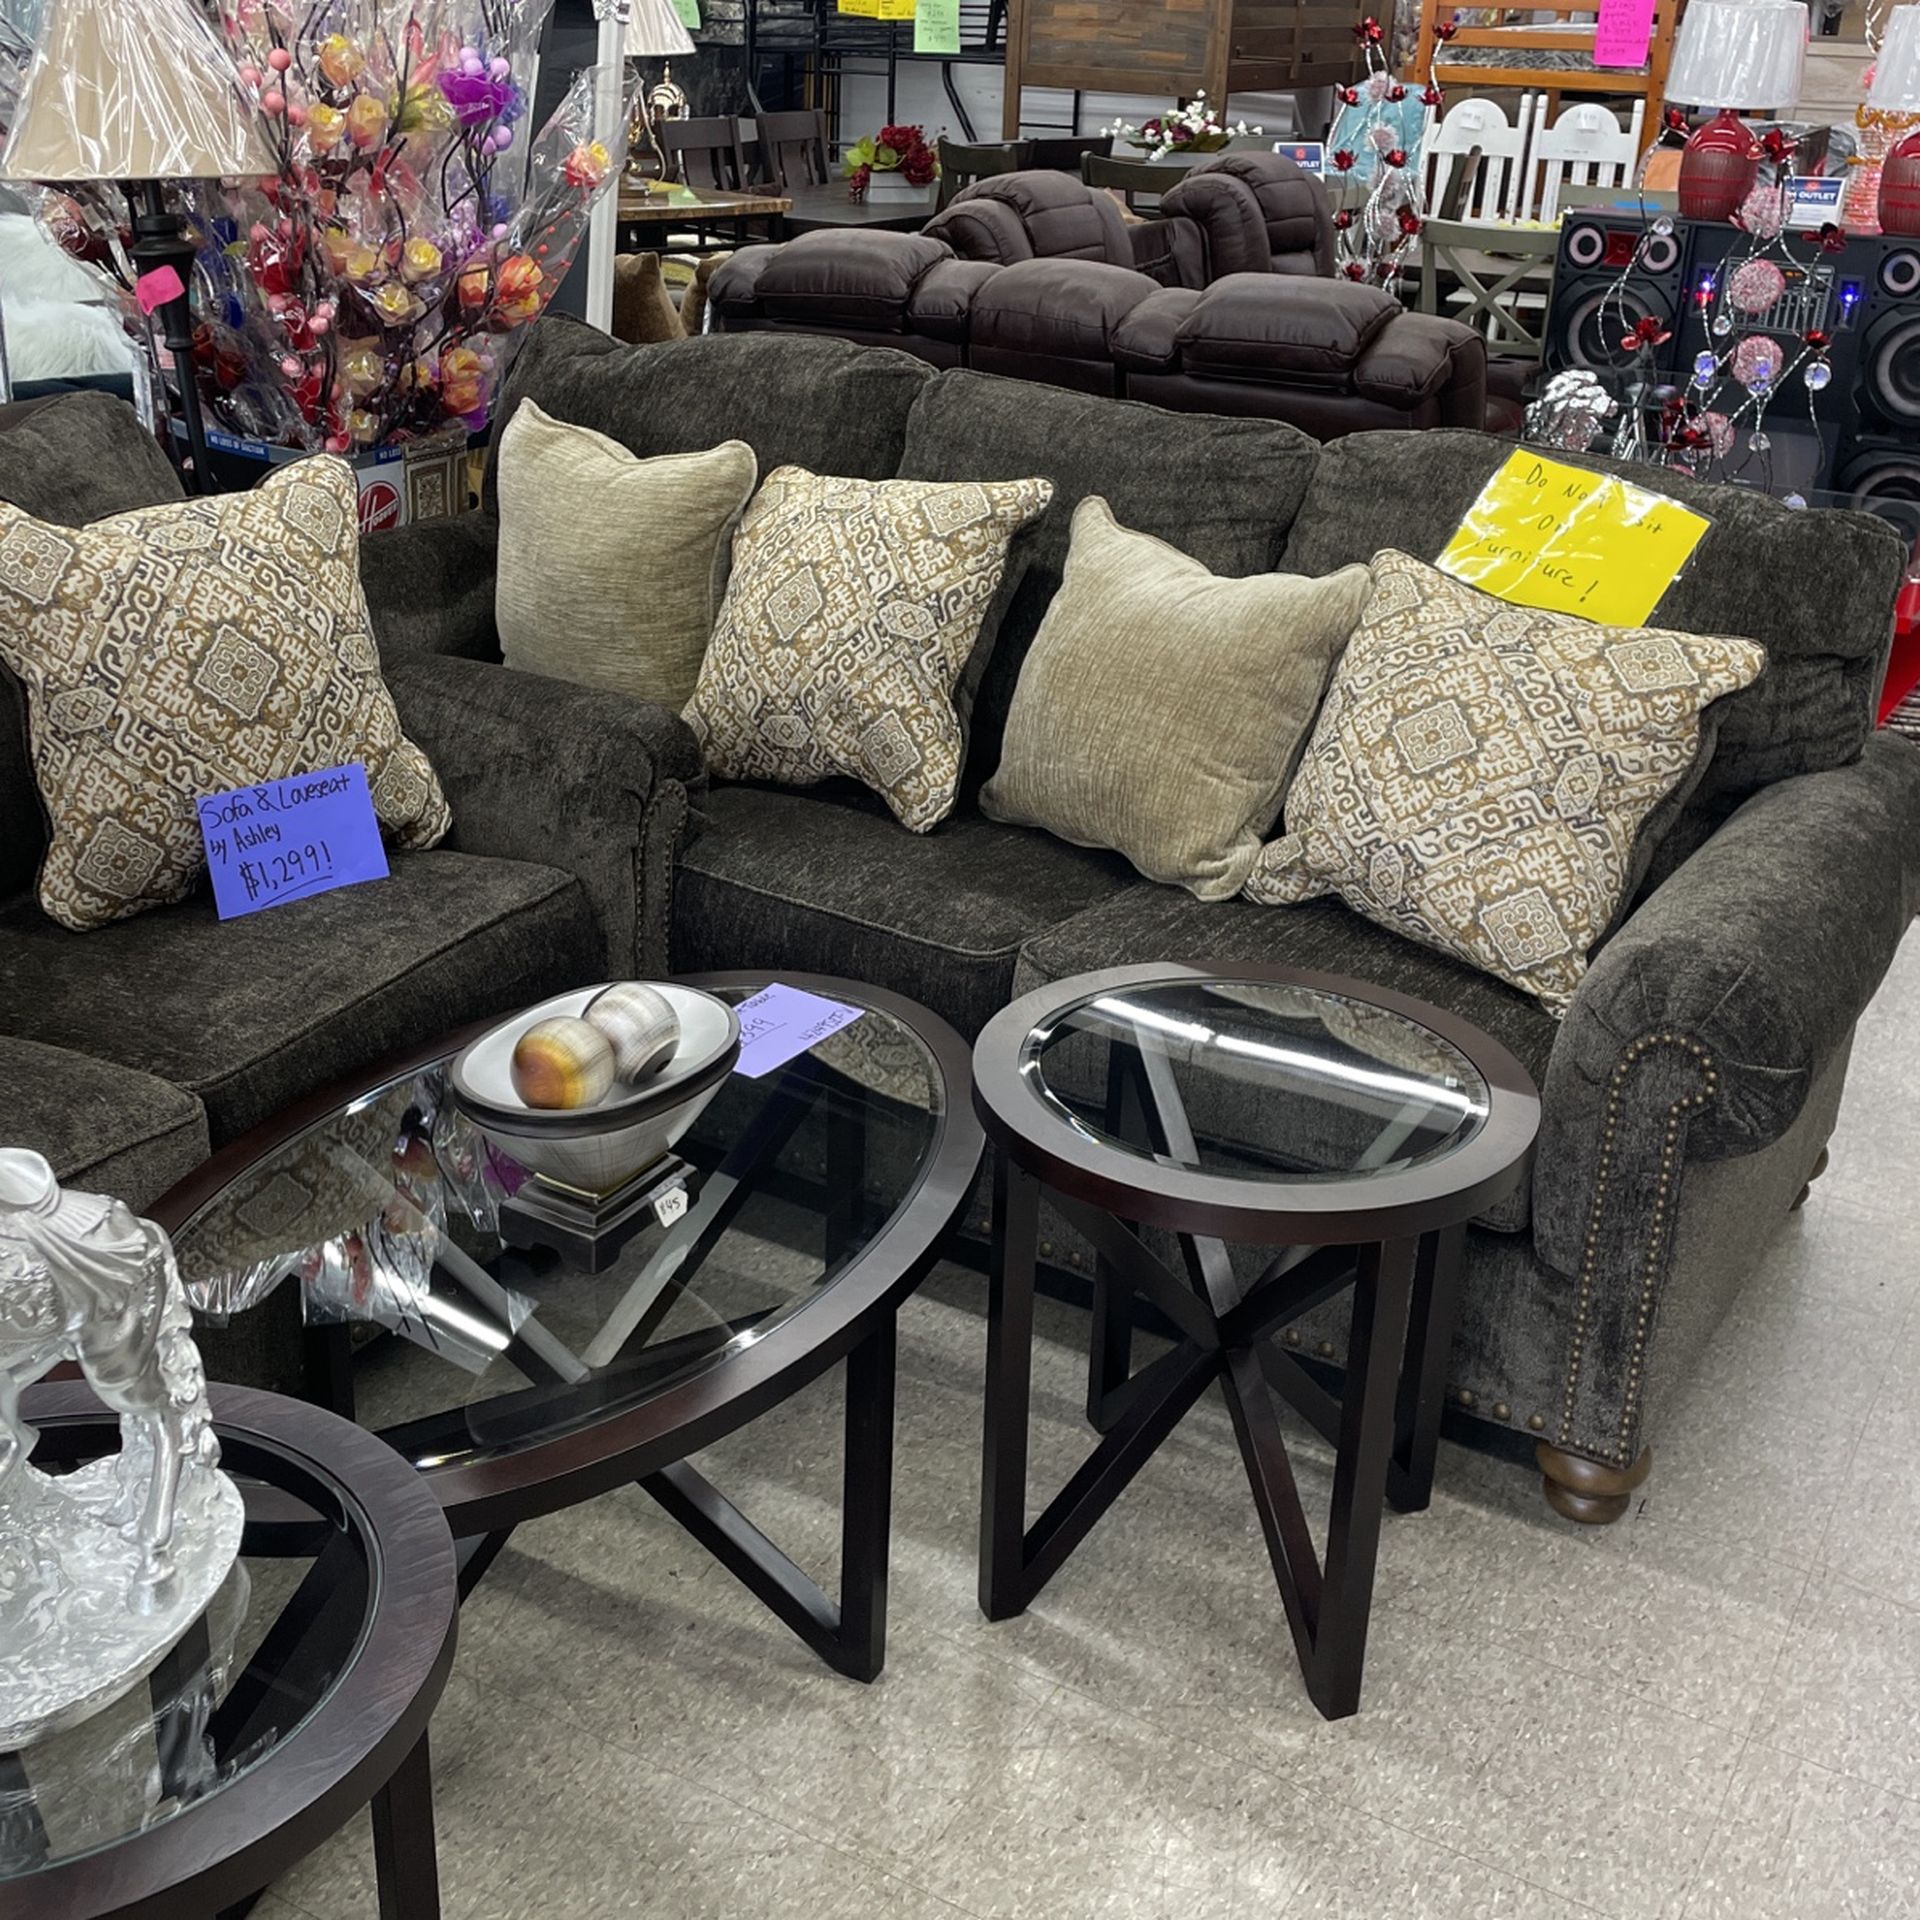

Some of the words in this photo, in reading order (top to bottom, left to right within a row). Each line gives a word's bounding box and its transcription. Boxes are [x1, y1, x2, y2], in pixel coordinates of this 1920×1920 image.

[1295, 160, 1321, 168] UTLET
[1799, 191, 1836, 200] OUTLET
[1525, 463, 1549, 488] Do
[200, 795, 254, 829] Sofa
[253, 787, 281, 812] &
[278, 773, 351, 810] Loveseat
[209, 838, 228, 864] by
[233, 823, 281, 853] Ashley
[239, 841, 333, 901] $1,299!
